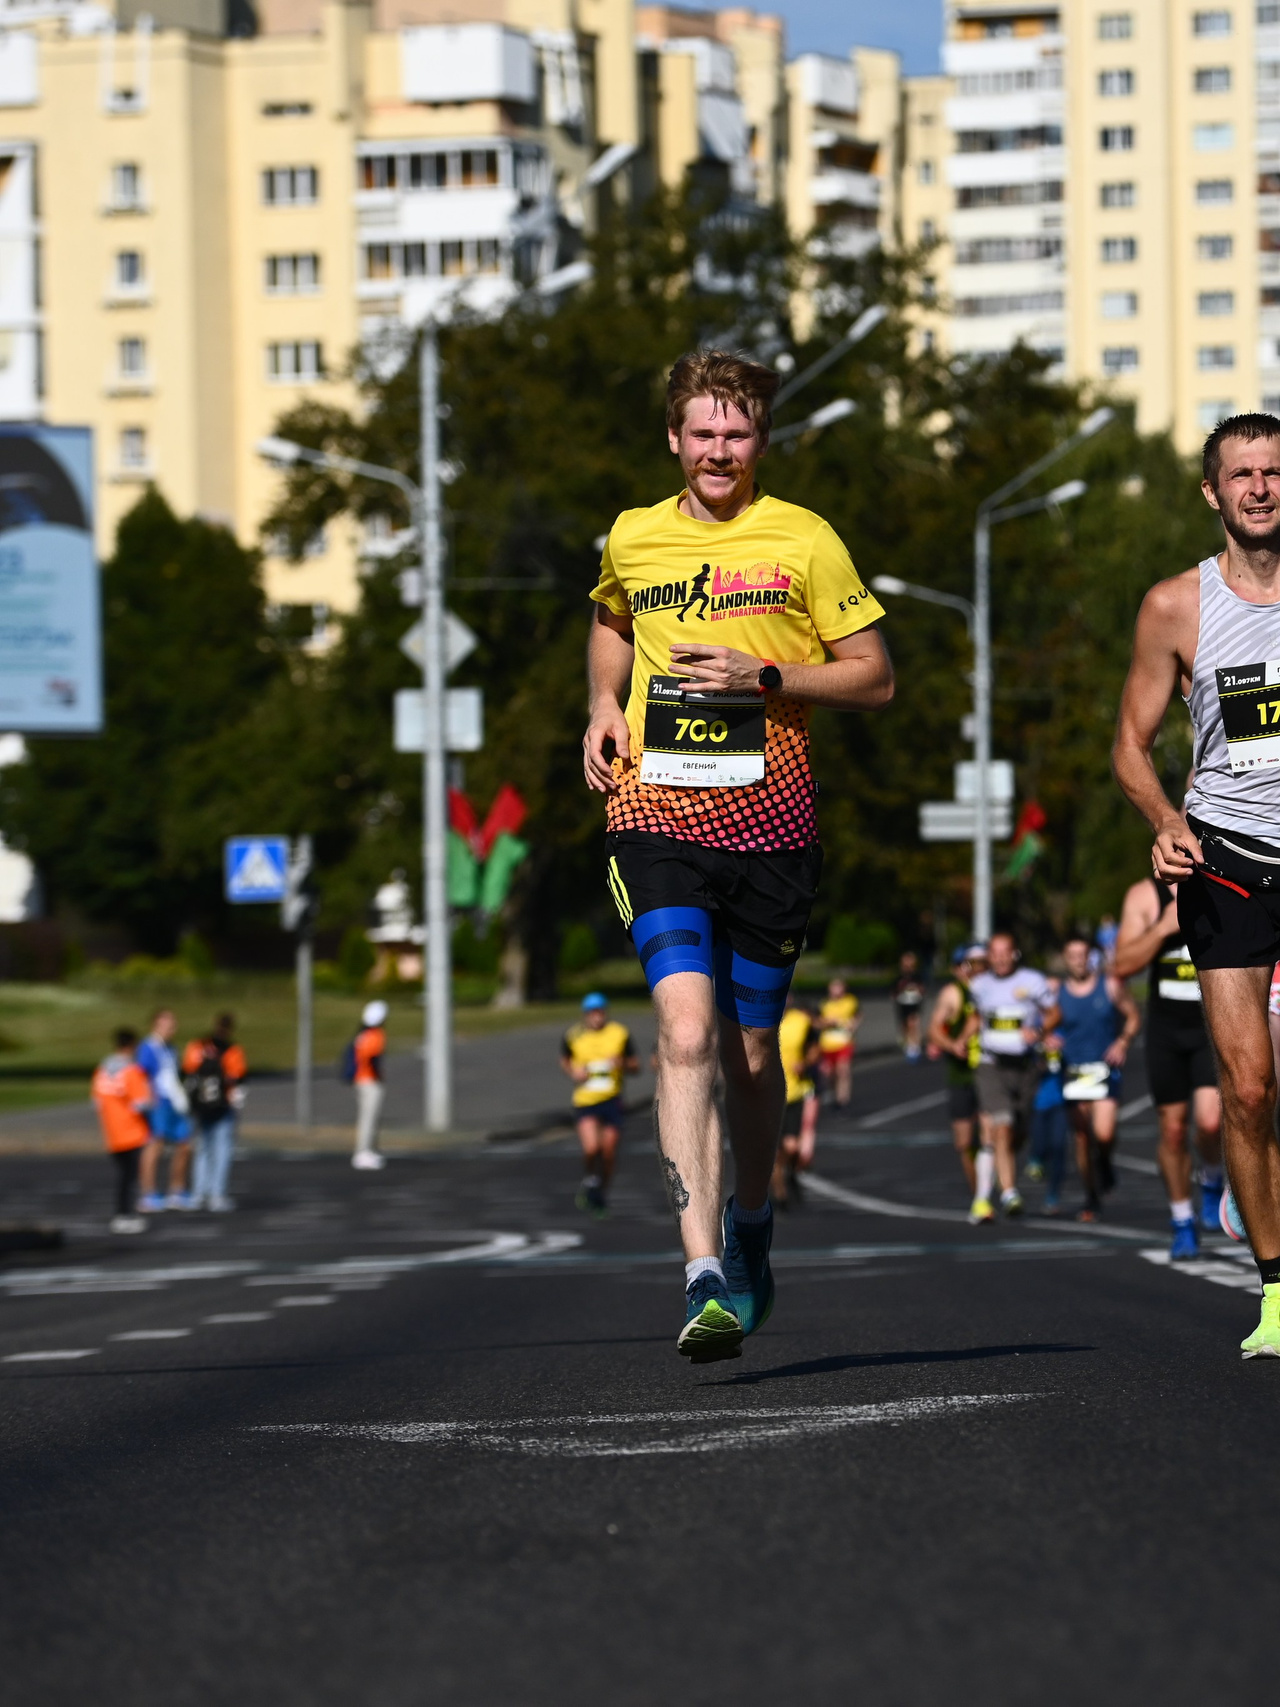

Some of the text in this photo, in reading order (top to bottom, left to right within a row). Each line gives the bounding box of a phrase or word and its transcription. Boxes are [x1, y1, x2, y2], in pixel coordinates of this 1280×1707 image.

[711, 590, 789, 612] LANDMARKS
[710, 610, 726, 622] HALF
[729, 606, 767, 618] MARATHON
[674, 718, 728, 742] 700
[682, 761, 717, 770] ЕВГЕНИЙ
